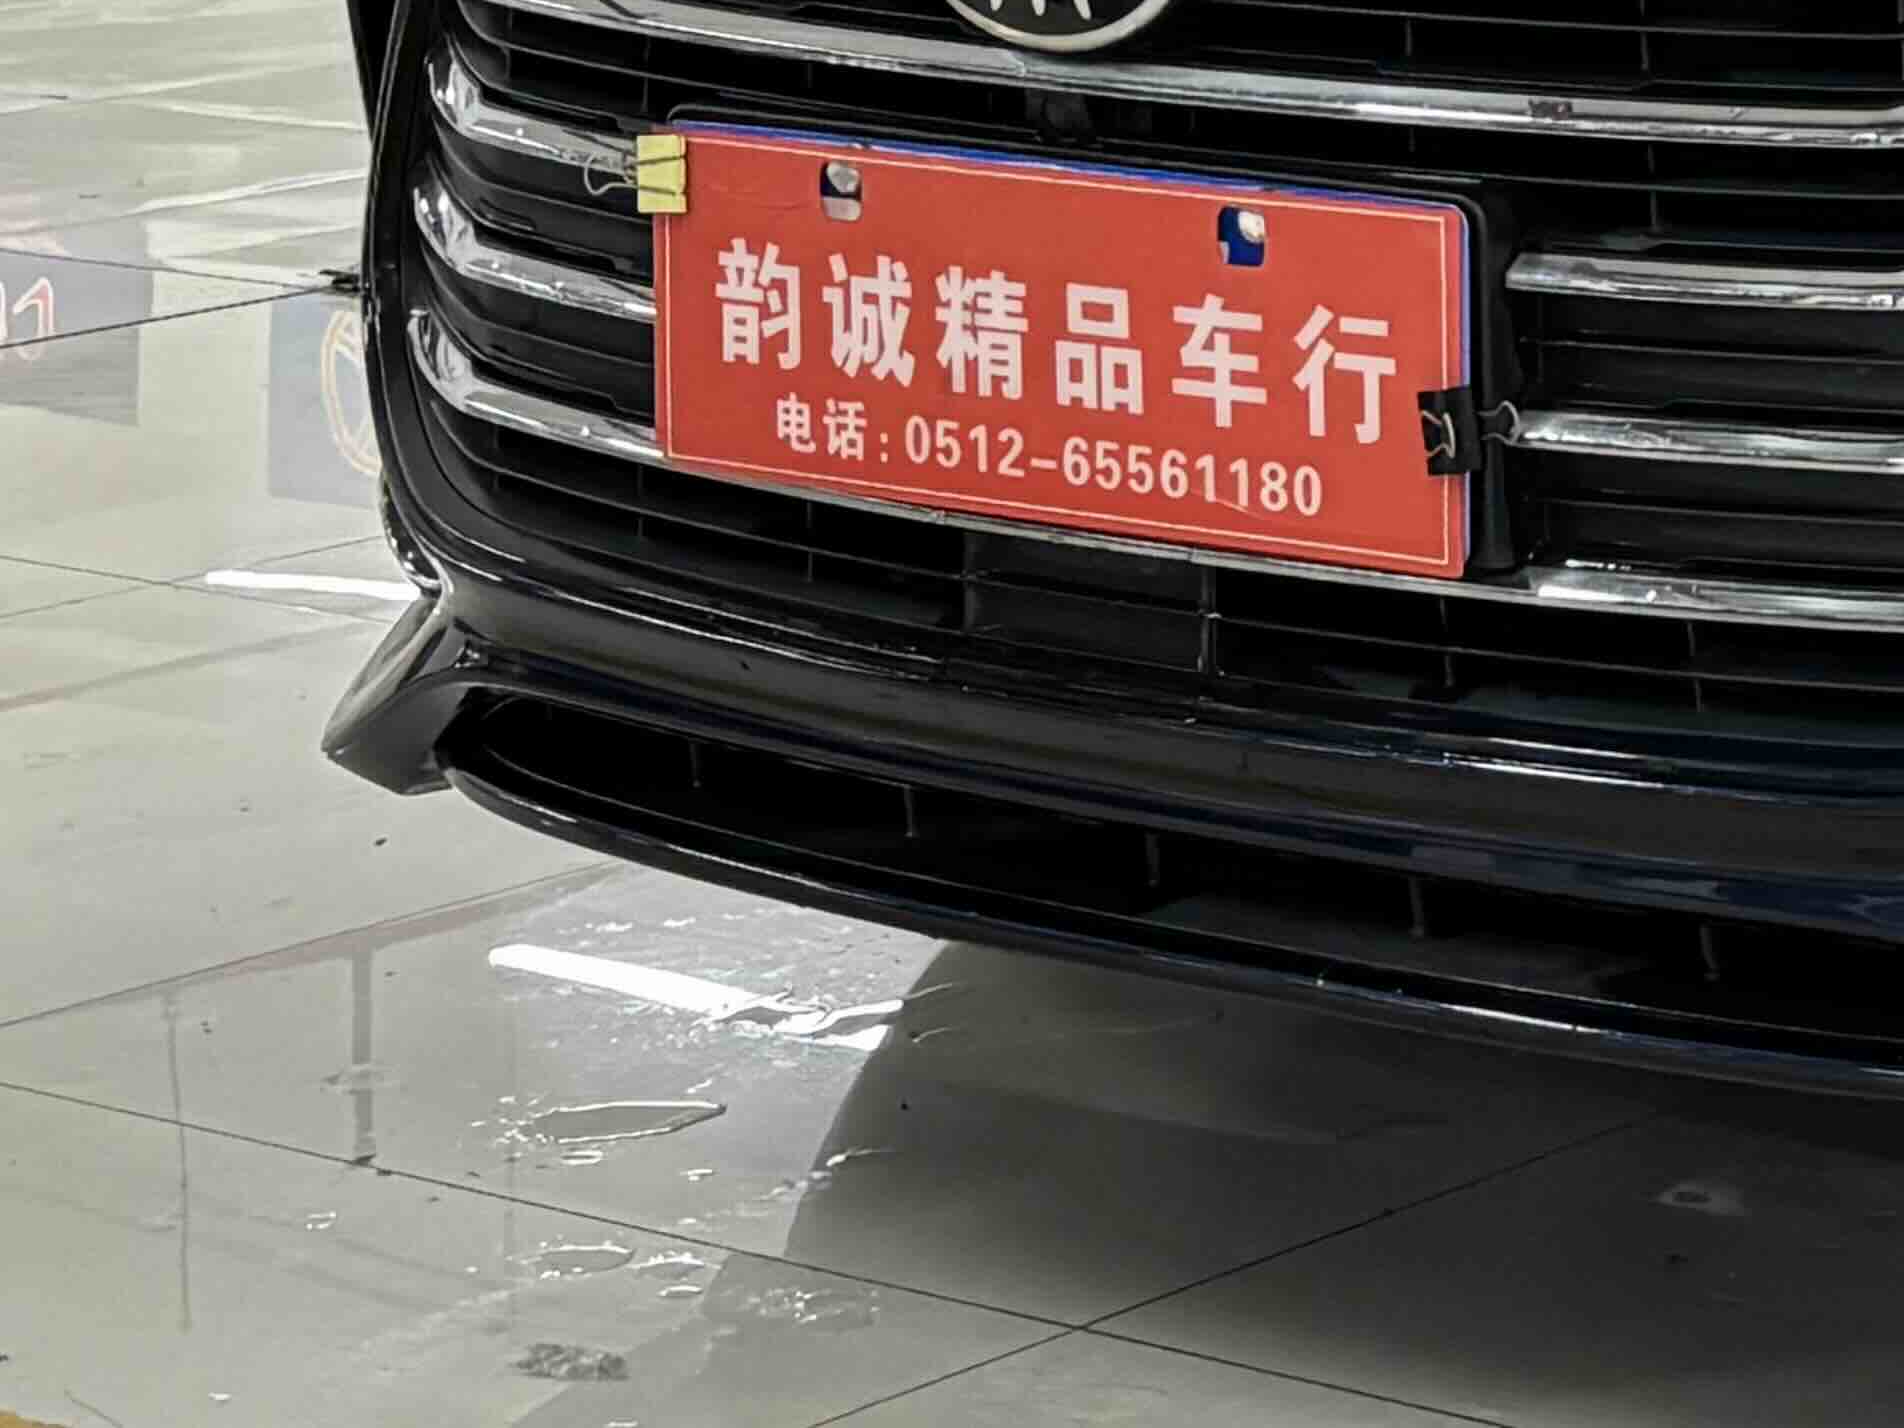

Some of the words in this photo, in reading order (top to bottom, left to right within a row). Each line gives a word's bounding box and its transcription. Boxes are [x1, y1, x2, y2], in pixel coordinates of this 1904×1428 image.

[714, 236, 1397, 444] 韵诚精品车行
